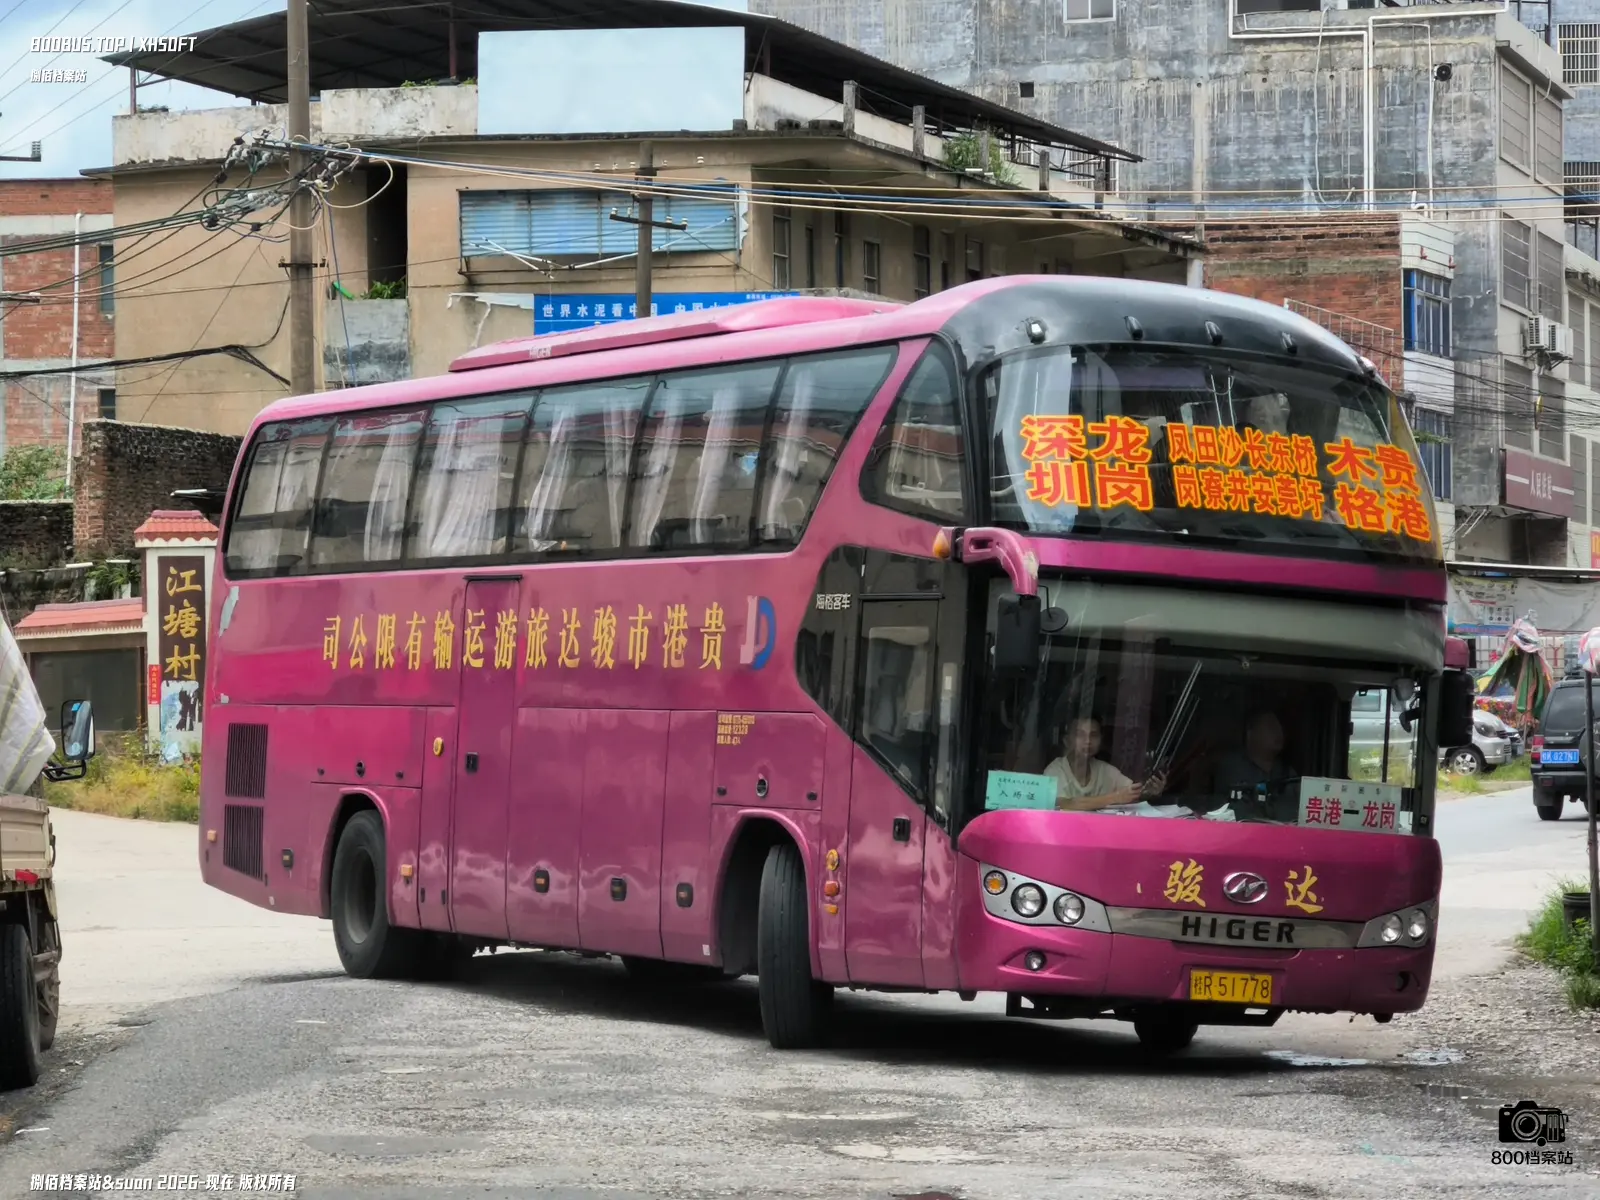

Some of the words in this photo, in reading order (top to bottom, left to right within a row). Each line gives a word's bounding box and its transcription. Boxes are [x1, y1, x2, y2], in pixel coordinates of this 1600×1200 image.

[816, 593, 851, 610] 海格客车
[163, 566, 202, 681] 江塘村
[1181, 915, 1296, 943] HIGER
